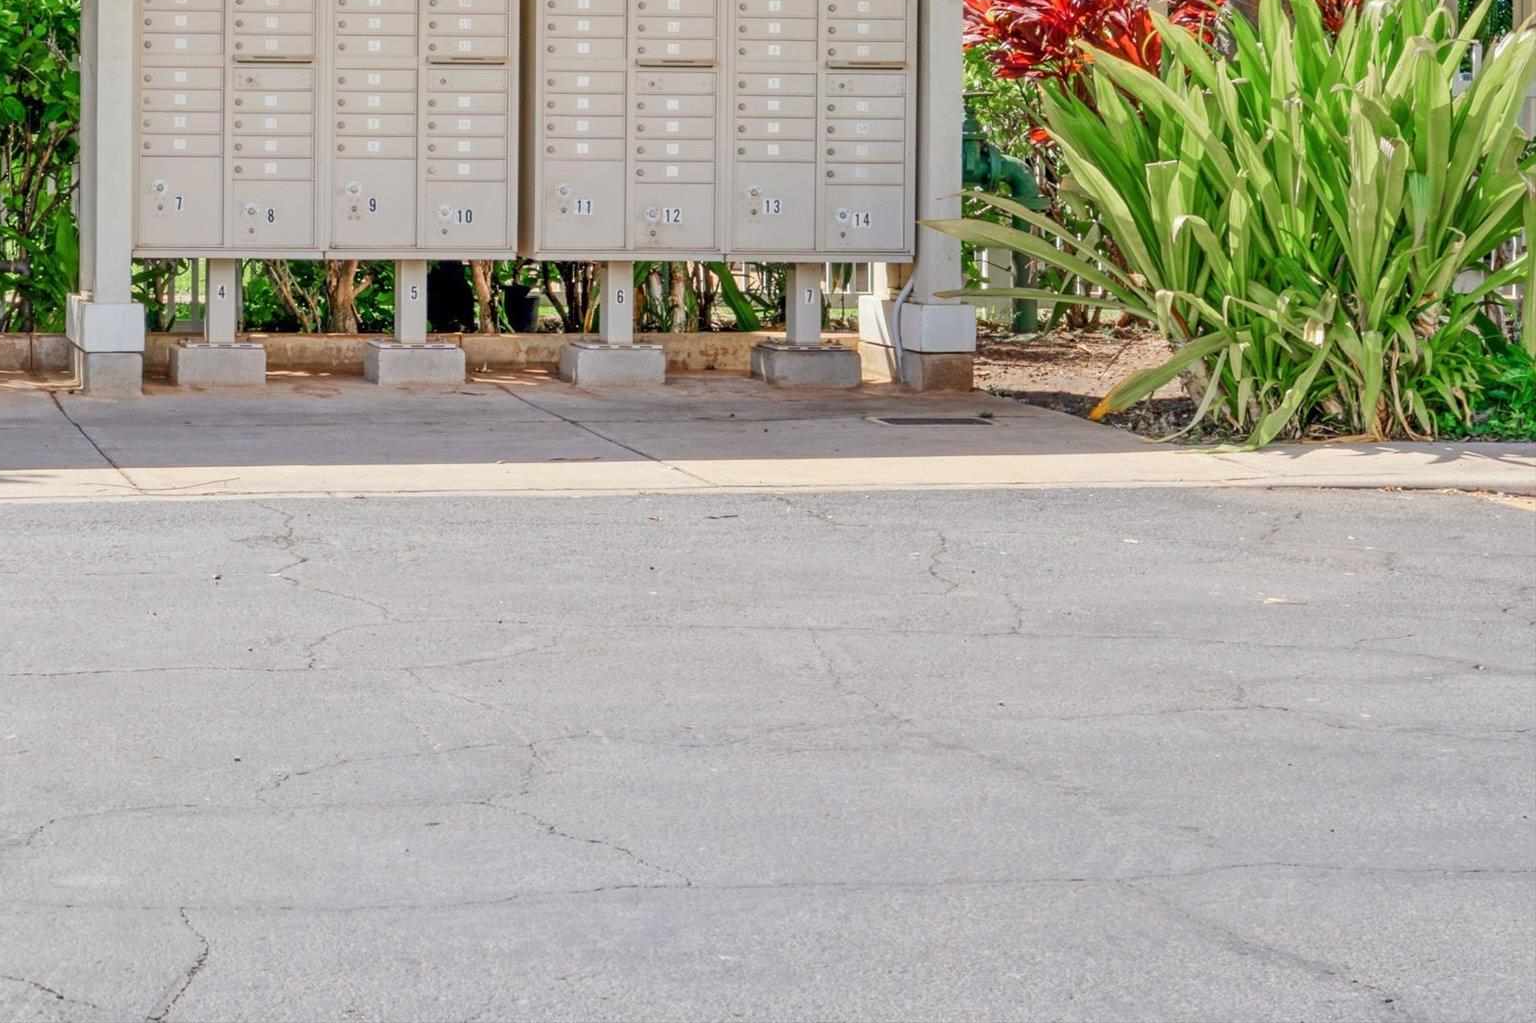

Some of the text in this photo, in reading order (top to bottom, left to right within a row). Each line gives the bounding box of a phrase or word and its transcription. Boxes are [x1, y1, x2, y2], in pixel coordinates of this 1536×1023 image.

[576, 199, 592, 215] 11
[764, 199, 782, 214] 13
[456, 208, 474, 224] 10
[664, 208, 682, 223] 12
[854, 212, 871, 227] 14
